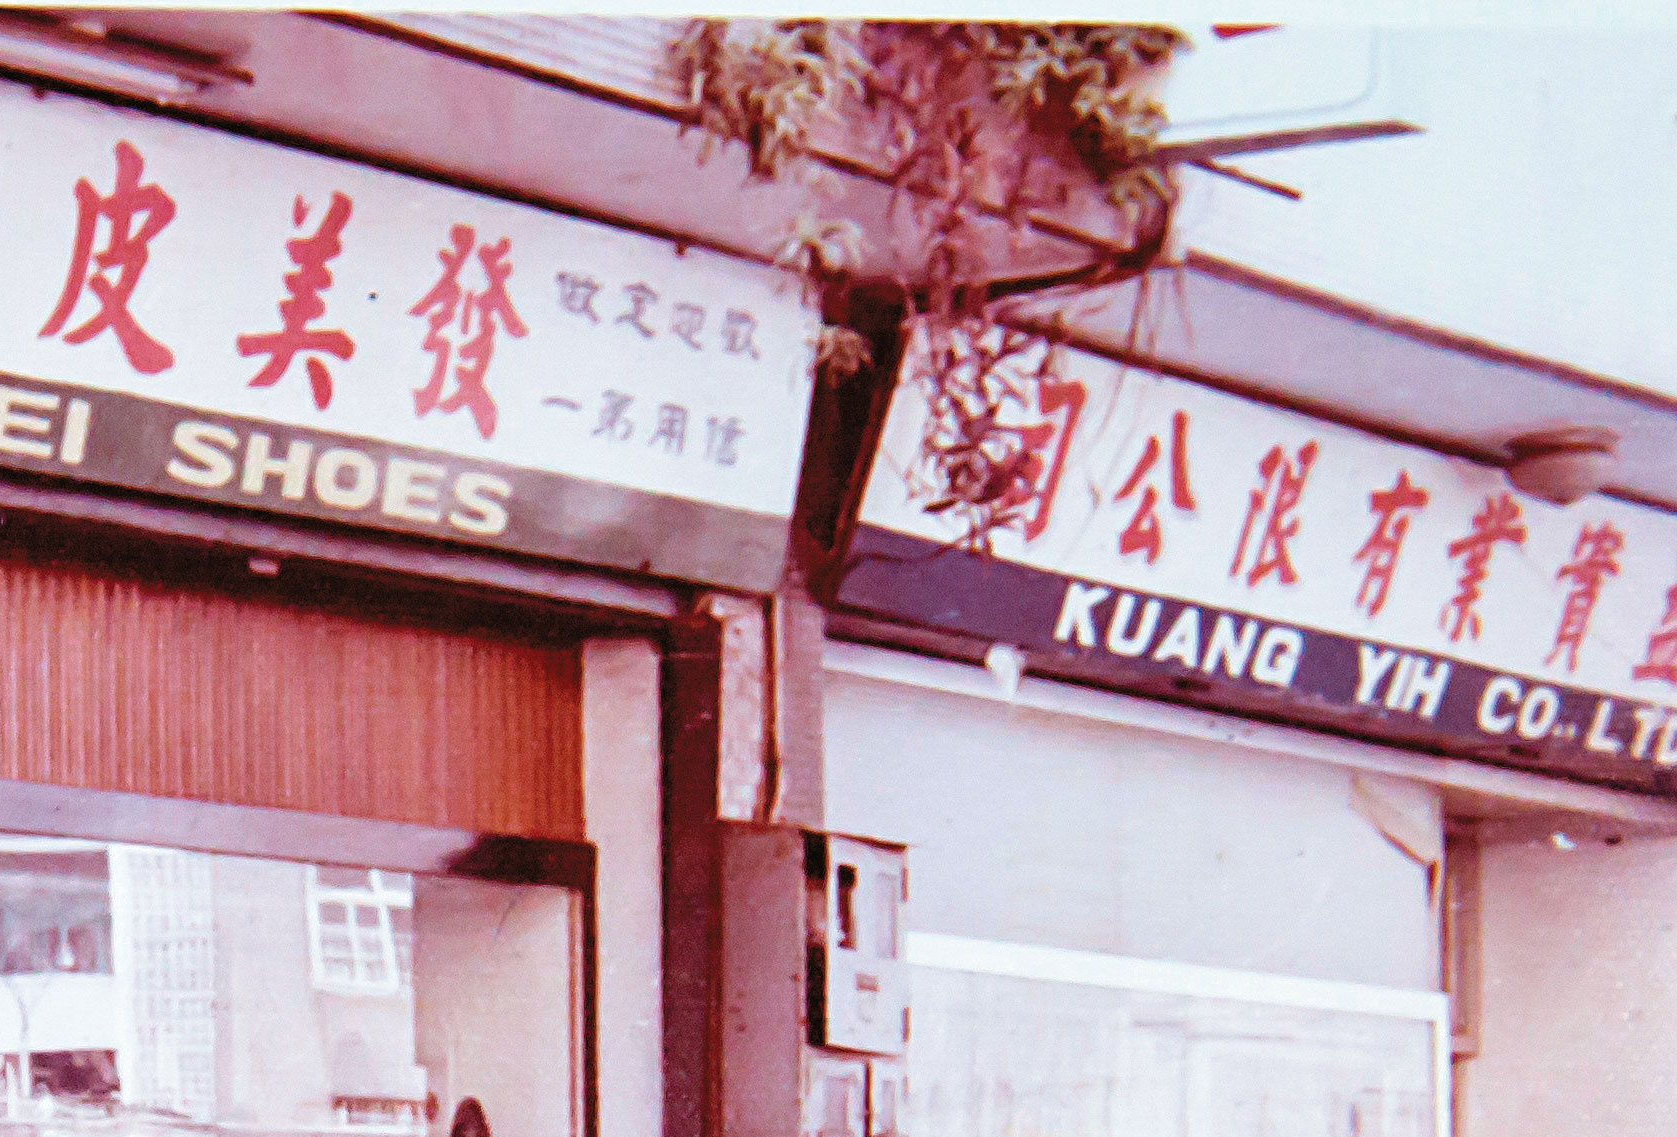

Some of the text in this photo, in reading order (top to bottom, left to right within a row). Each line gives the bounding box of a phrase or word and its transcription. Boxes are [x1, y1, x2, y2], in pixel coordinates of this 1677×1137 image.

[166, 421, 514, 535] SHOES
[1053, 582, 1305, 688] KUANG
[1356, 643, 1452, 720] YIH
